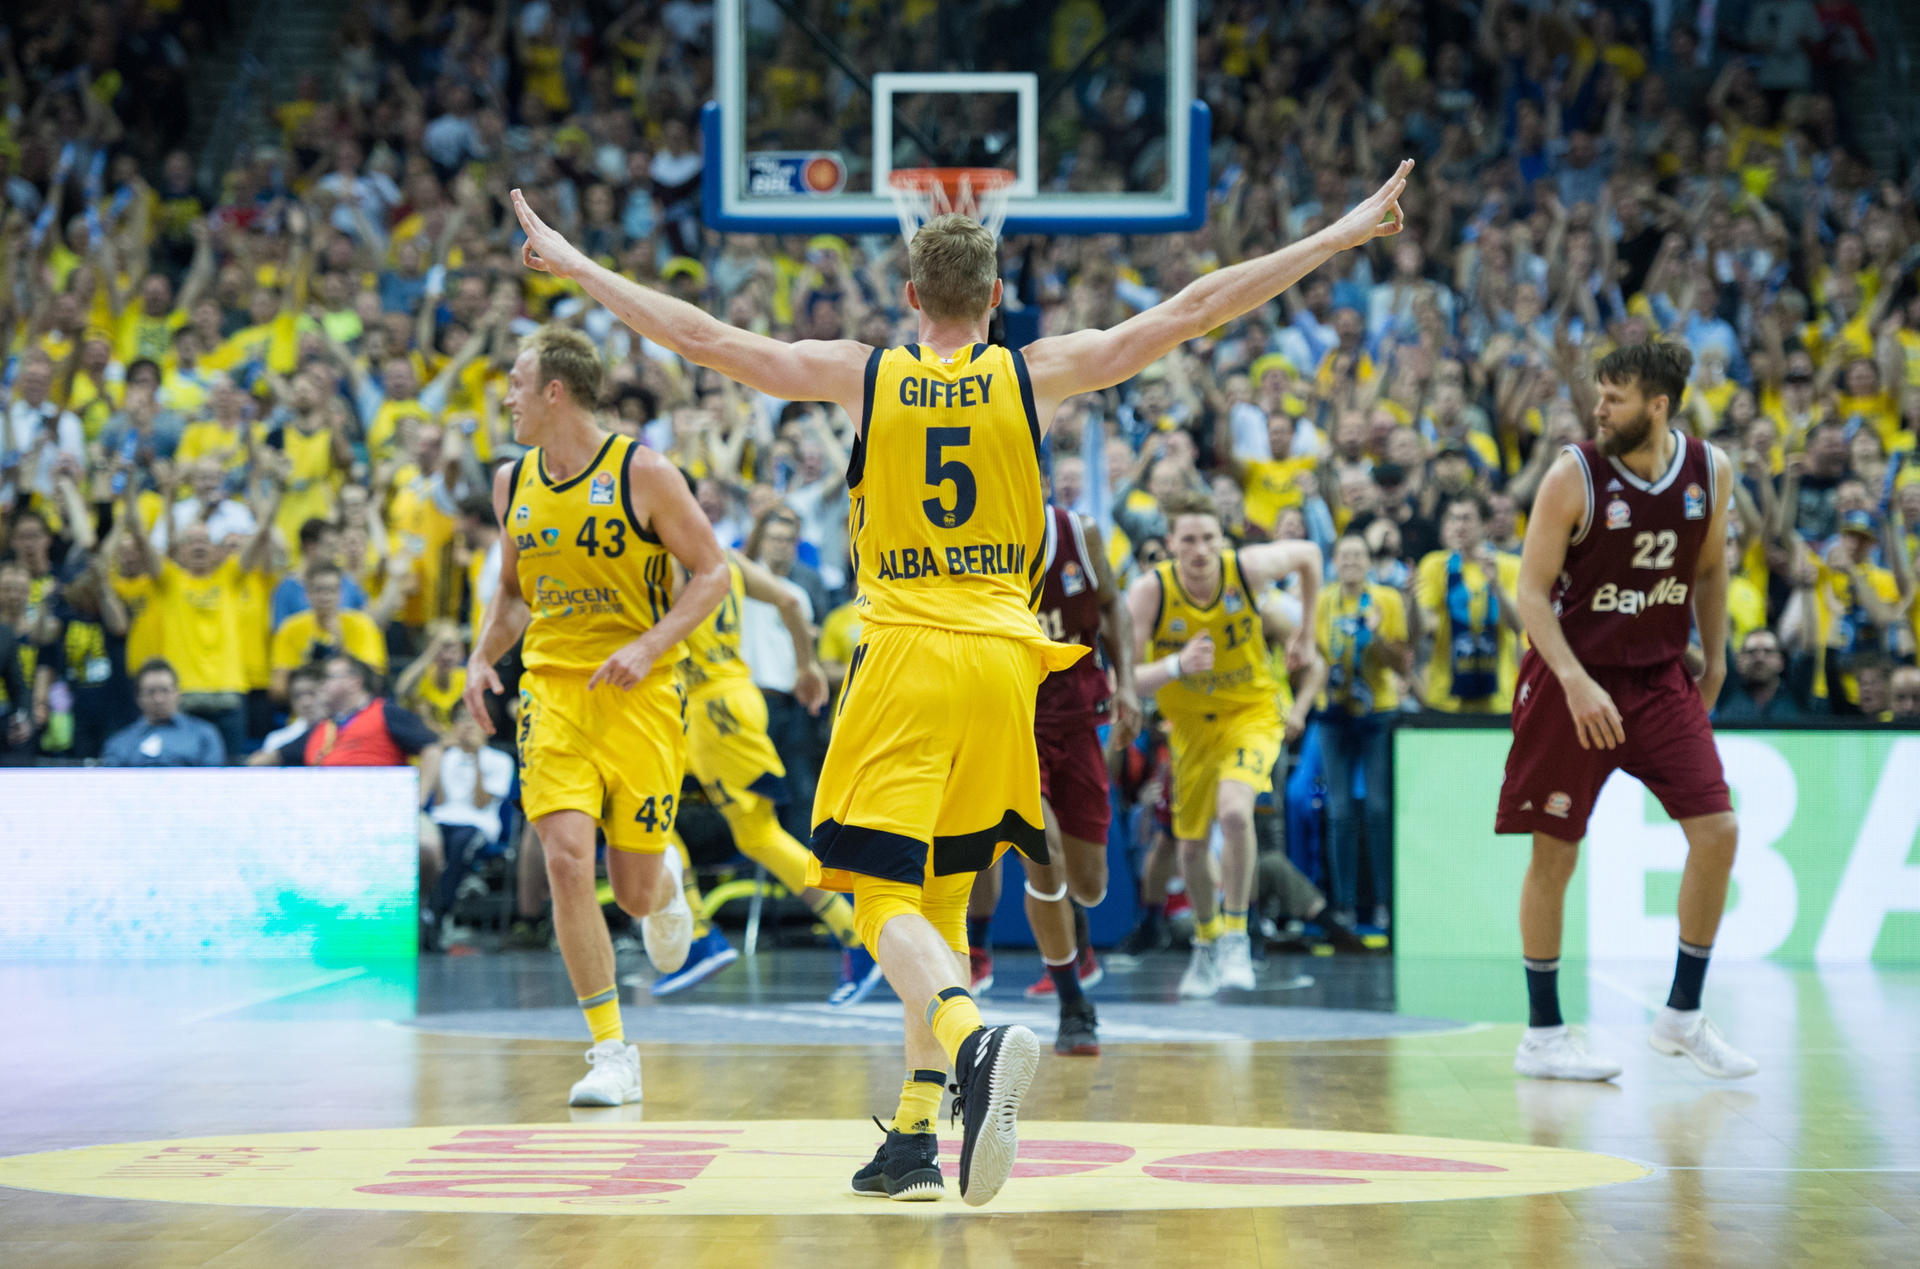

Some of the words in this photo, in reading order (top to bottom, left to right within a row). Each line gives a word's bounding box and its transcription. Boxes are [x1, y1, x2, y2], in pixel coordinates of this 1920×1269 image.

[899, 373, 993, 409] GIFFEY
[922, 426, 977, 529] 5
[576, 516, 626, 559] 43
[1631, 529, 1678, 570] 22
[878, 546, 940, 581] ALBA
[945, 543, 1026, 576] BERLIN
[1225, 616, 1253, 650] 13
[1236, 747, 1264, 775] 13
[634, 794, 674, 834] 43
